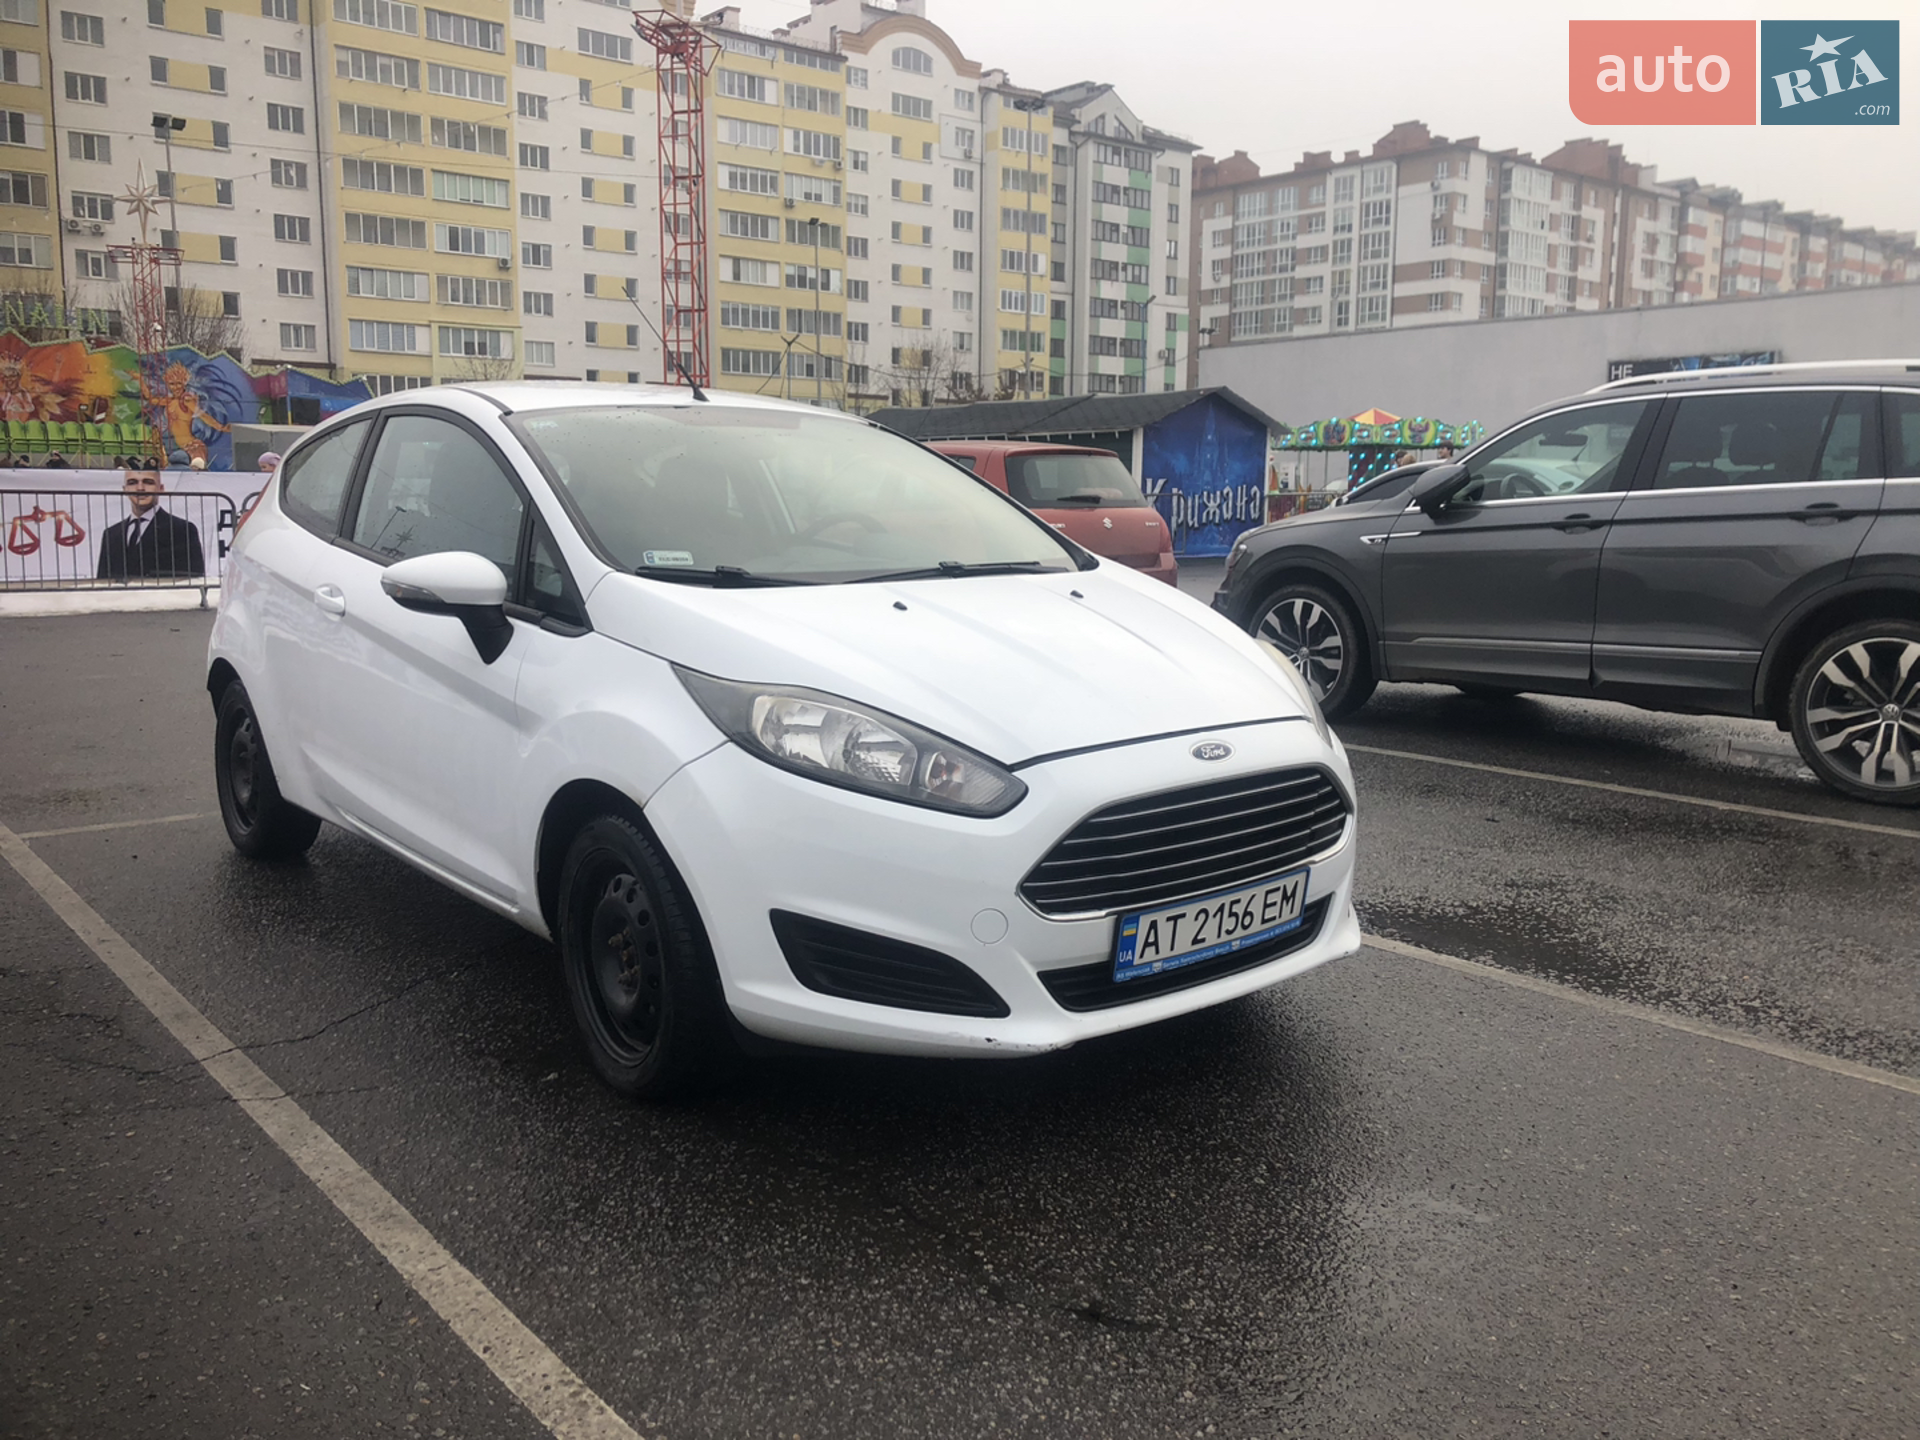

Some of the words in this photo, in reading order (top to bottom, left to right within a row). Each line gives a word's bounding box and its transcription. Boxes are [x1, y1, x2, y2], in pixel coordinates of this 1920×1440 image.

[1145, 477, 1261, 538] Крижана
[1200, 745, 1225, 758] Ford
[1139, 912, 1187, 959] AT
[1191, 893, 1257, 946] 2156
[1261, 880, 1299, 925] EM
[1119, 949, 1133, 963] UA
